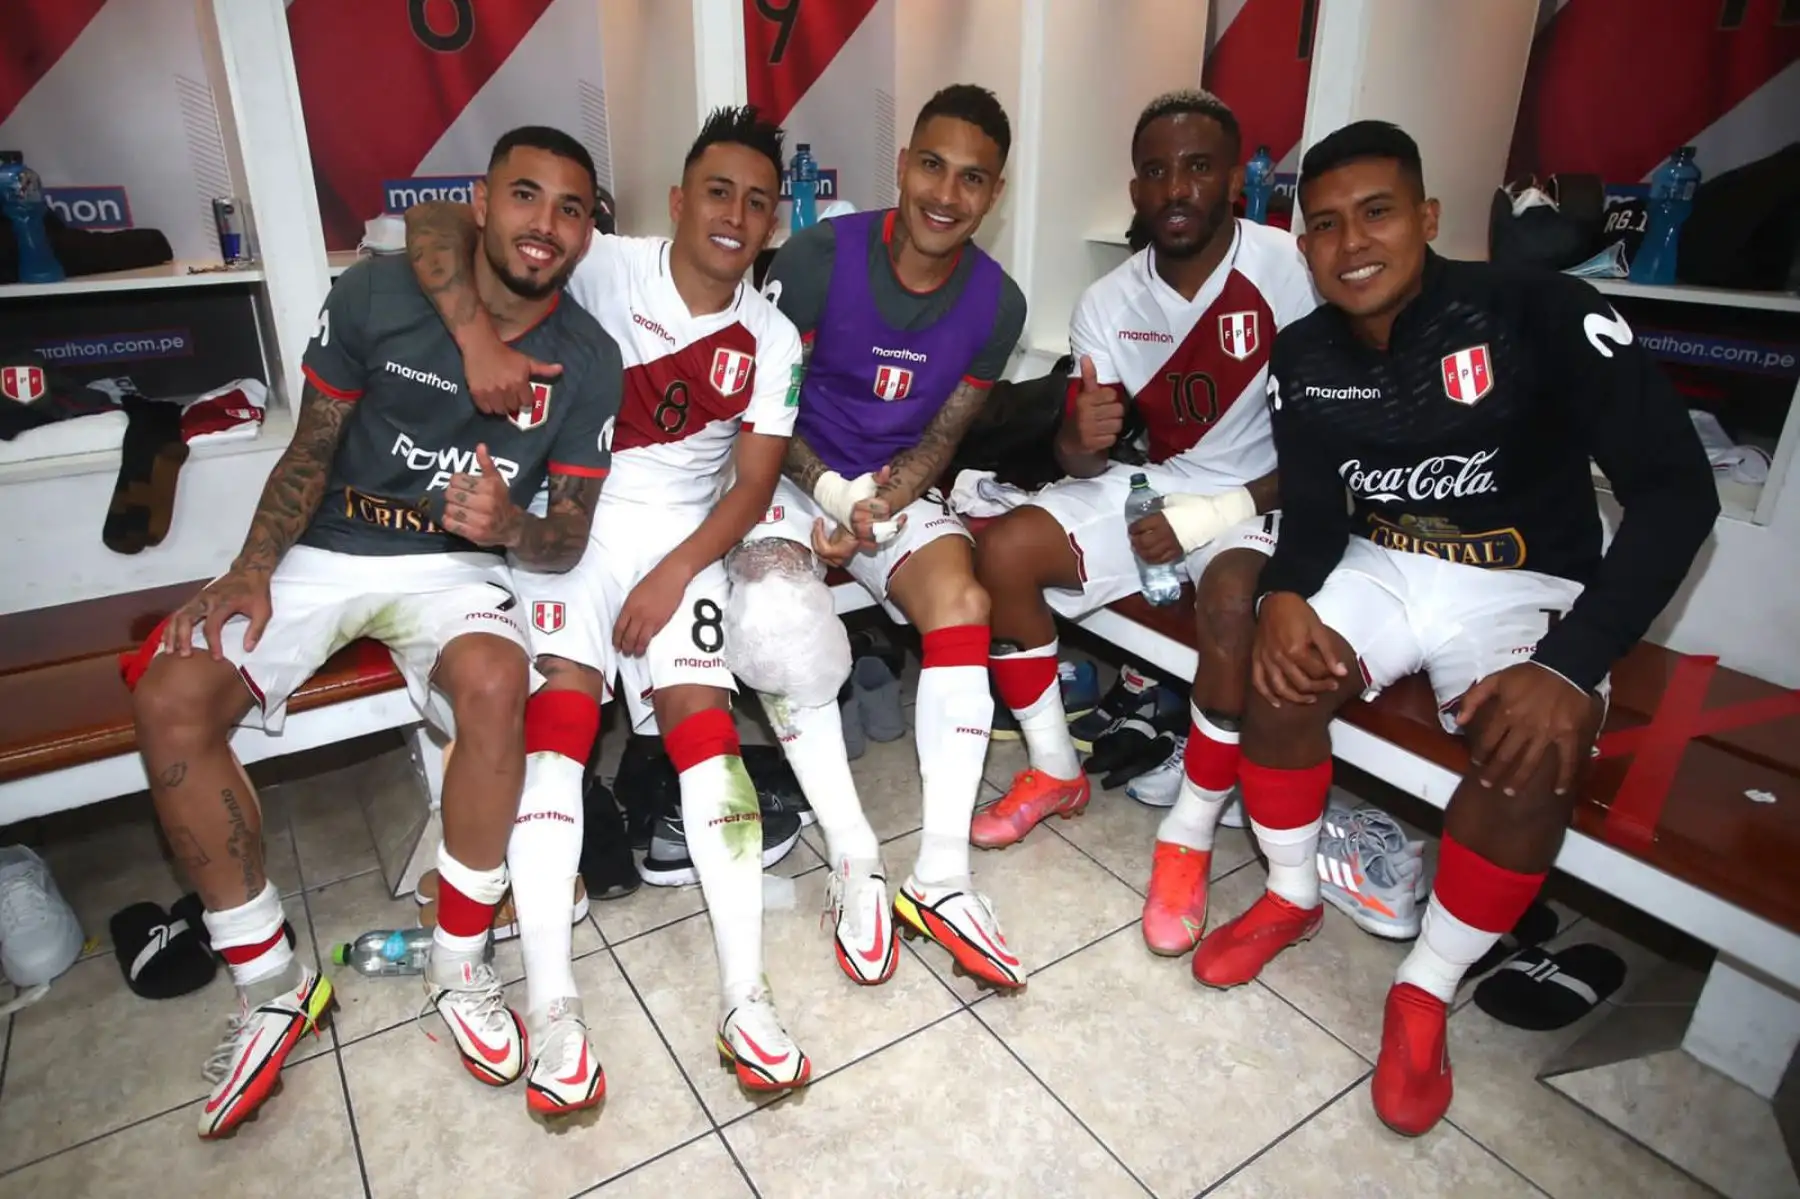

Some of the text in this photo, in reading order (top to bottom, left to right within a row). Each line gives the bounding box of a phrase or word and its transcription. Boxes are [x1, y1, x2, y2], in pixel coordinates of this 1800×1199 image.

[1118, 330, 1174, 343] marathon
[872, 346, 927, 363] marathon
[385, 360, 459, 395] marathon
[1166, 371, 1219, 424] 10
[1305, 386, 1382, 400] marathon
[654, 380, 688, 434] 8
[691, 598, 724, 653] 8
[513, 811, 575, 825] arathon
